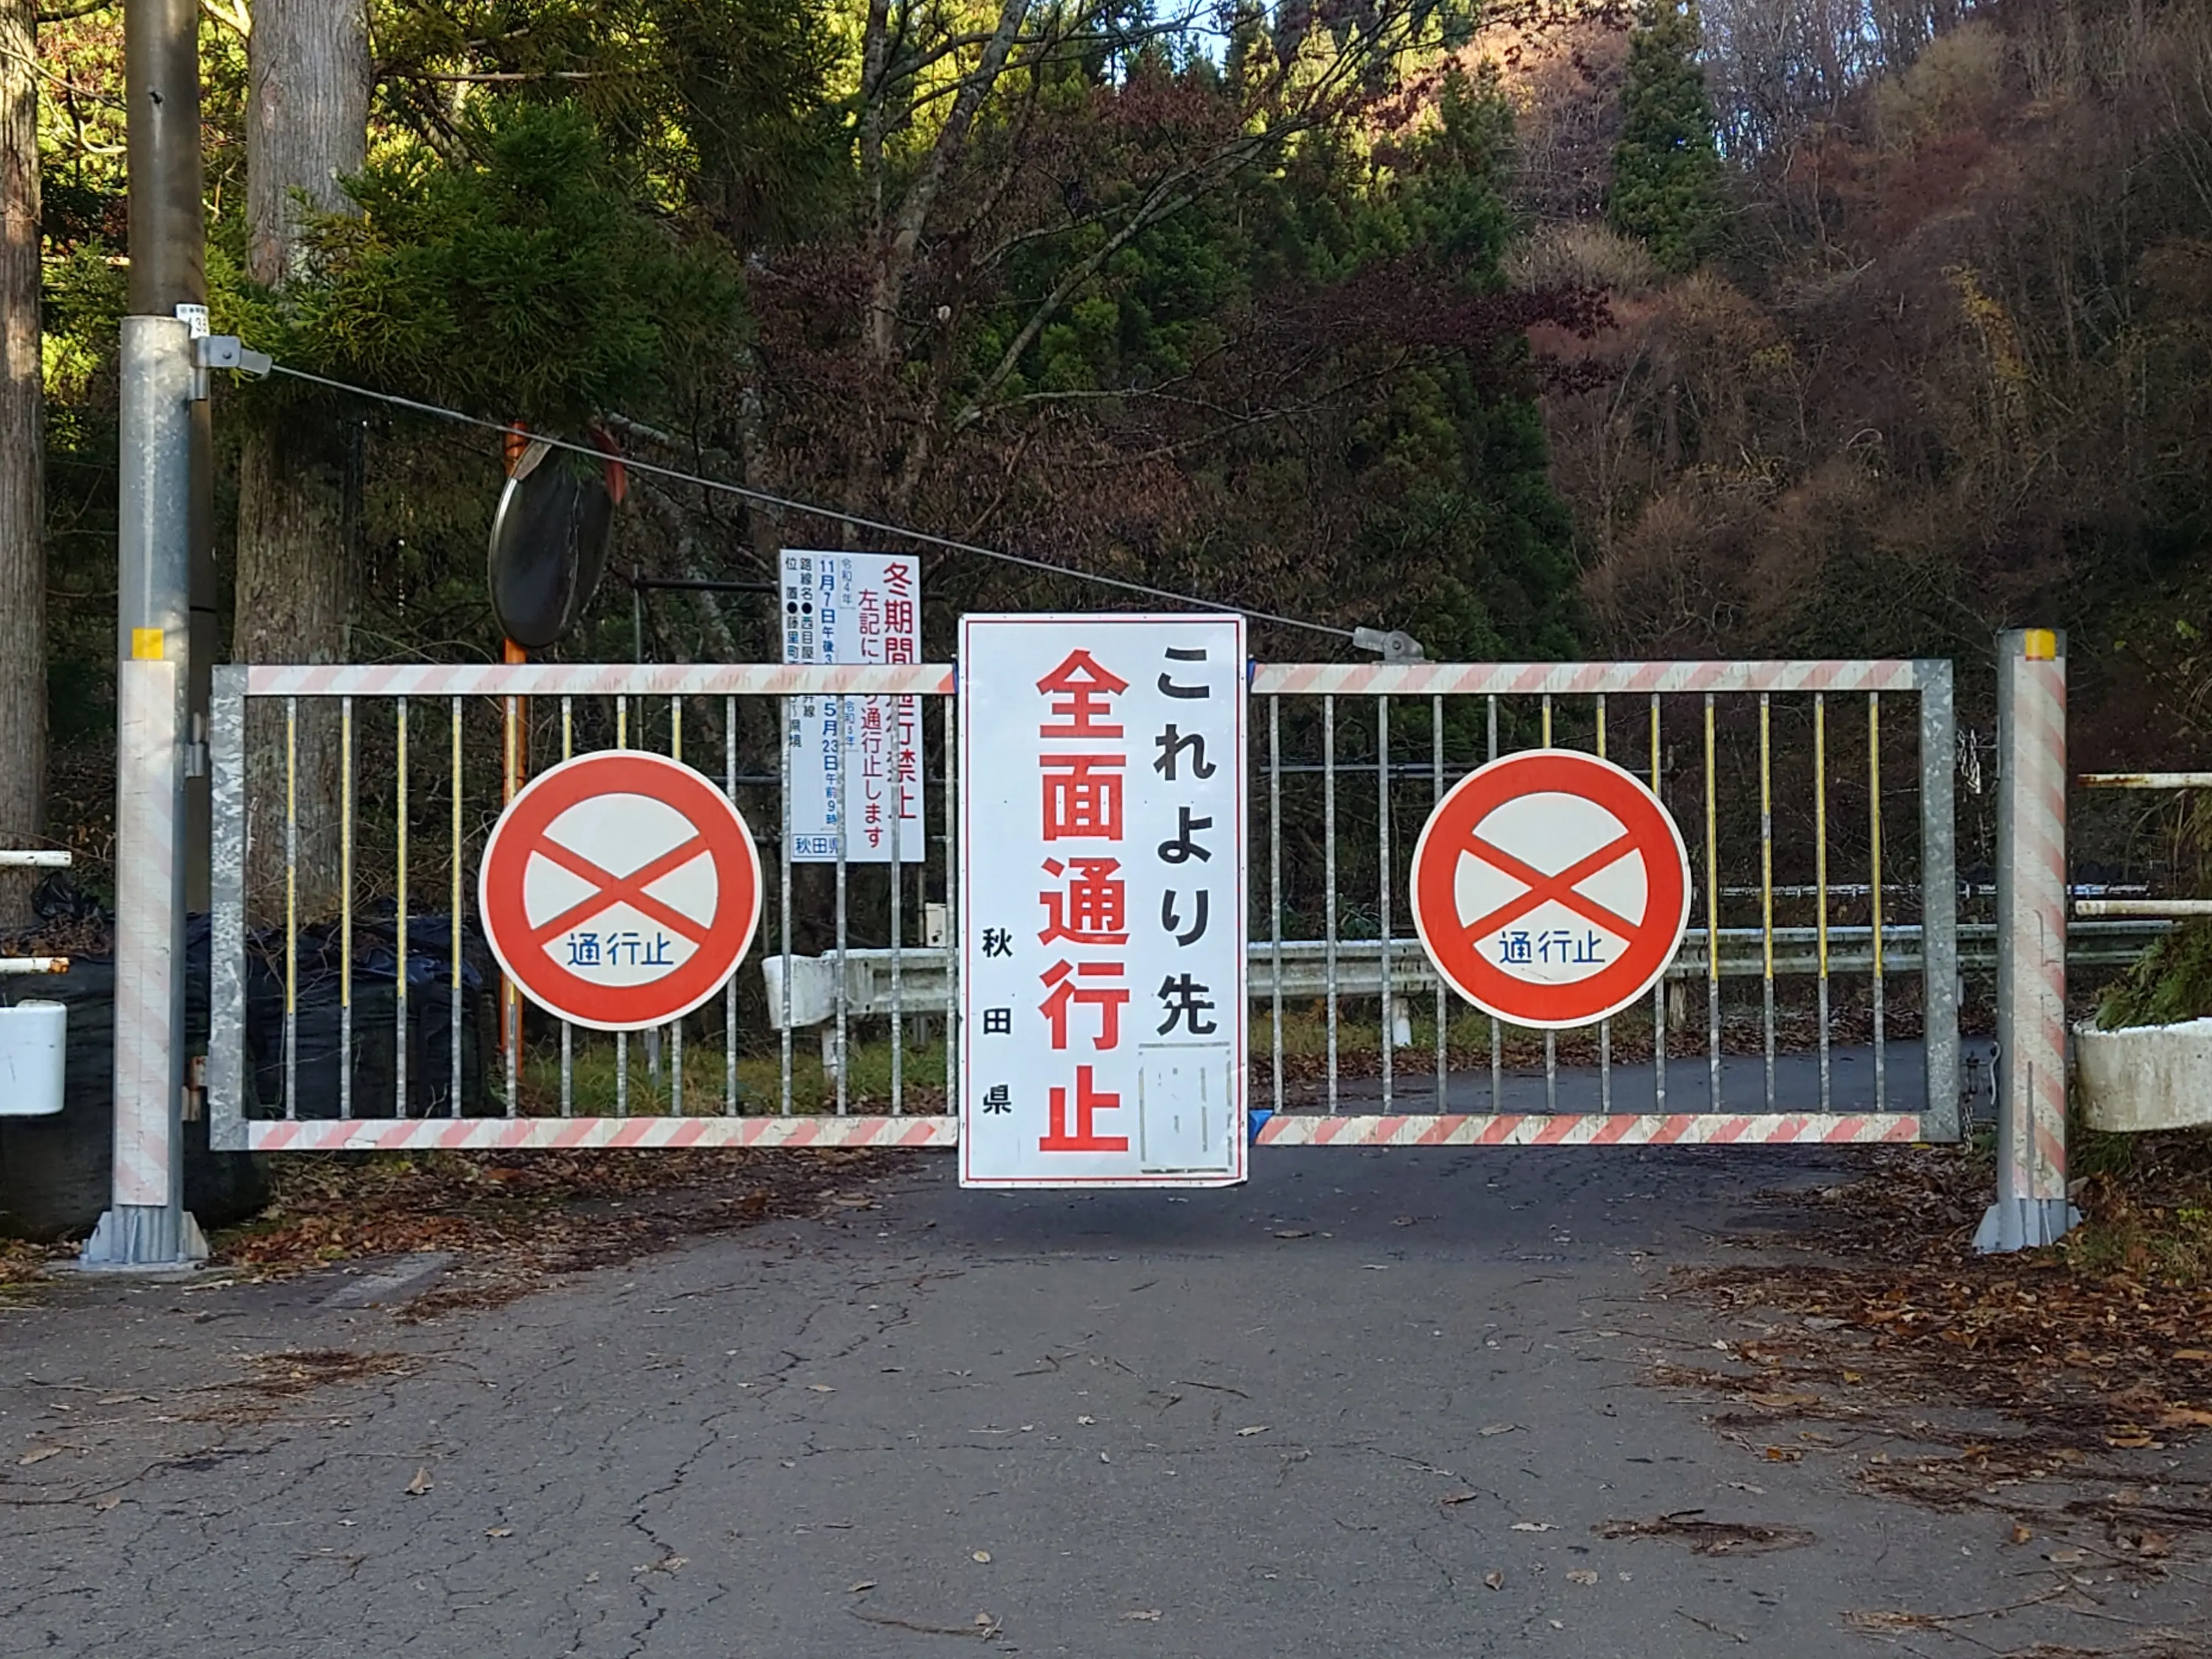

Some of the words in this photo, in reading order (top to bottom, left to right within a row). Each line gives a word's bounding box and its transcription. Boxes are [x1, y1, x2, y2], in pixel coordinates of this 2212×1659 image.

[1036, 648, 1130, 1153] 全面通行止
[1153, 647, 1218, 1037] これより先
[566, 932, 674, 966] 通行止
[981, 927, 1014, 1116] 秋田県
[1498, 929, 1606, 963] 通行止
